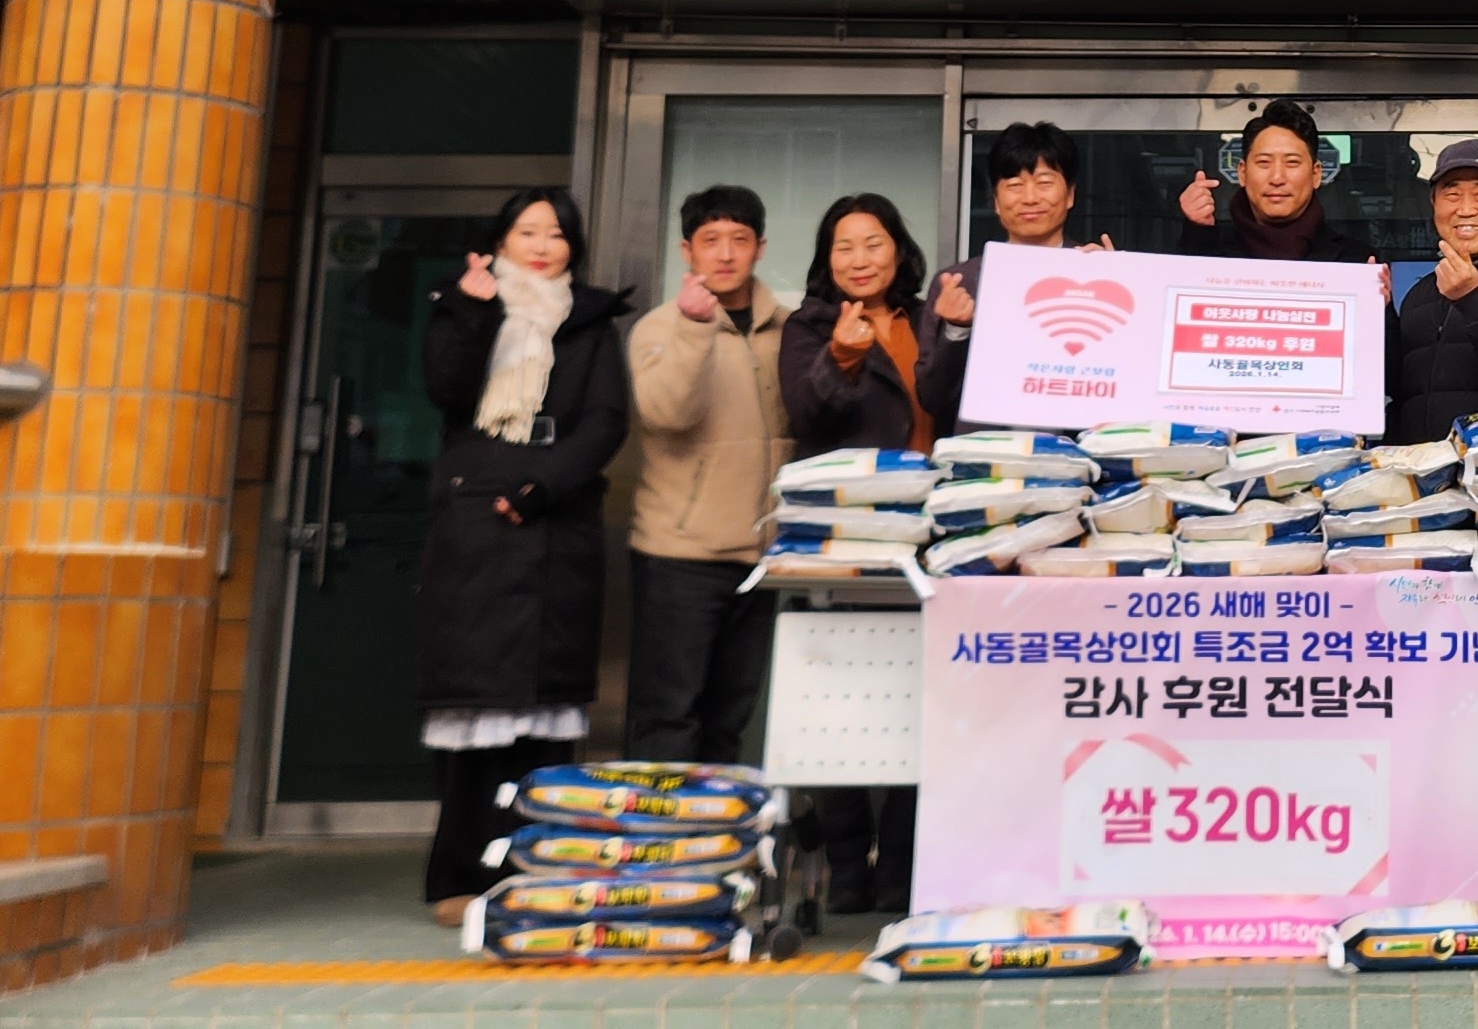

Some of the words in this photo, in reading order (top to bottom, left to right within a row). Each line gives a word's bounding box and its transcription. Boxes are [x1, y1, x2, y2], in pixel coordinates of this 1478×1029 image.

[1203, 307, 1259, 321] 이웃사랑
[1262, 310, 1317, 323] 나눔실천
[1201, 333, 1219, 348] 쌀
[1224, 335, 1277, 351] 320kg
[1283, 337, 1316, 352] 후원
[1022, 376, 1117, 399] 하트파이
[1127, 591, 1201, 618] 2026
[1210, 591, 1265, 618] 새해
[1276, 591, 1330, 618] 맞이
[951, 630, 1181, 664] 사동골목상인회
[1193, 630, 1290, 664] 특조금
[1301, 630, 1353, 663] 2억
[1365, 630, 1429, 663] 확보
[1063, 675, 1149, 719] 감사
[1162, 675, 1248, 719] 후원
[1264, 675, 1393, 719] 전달식
